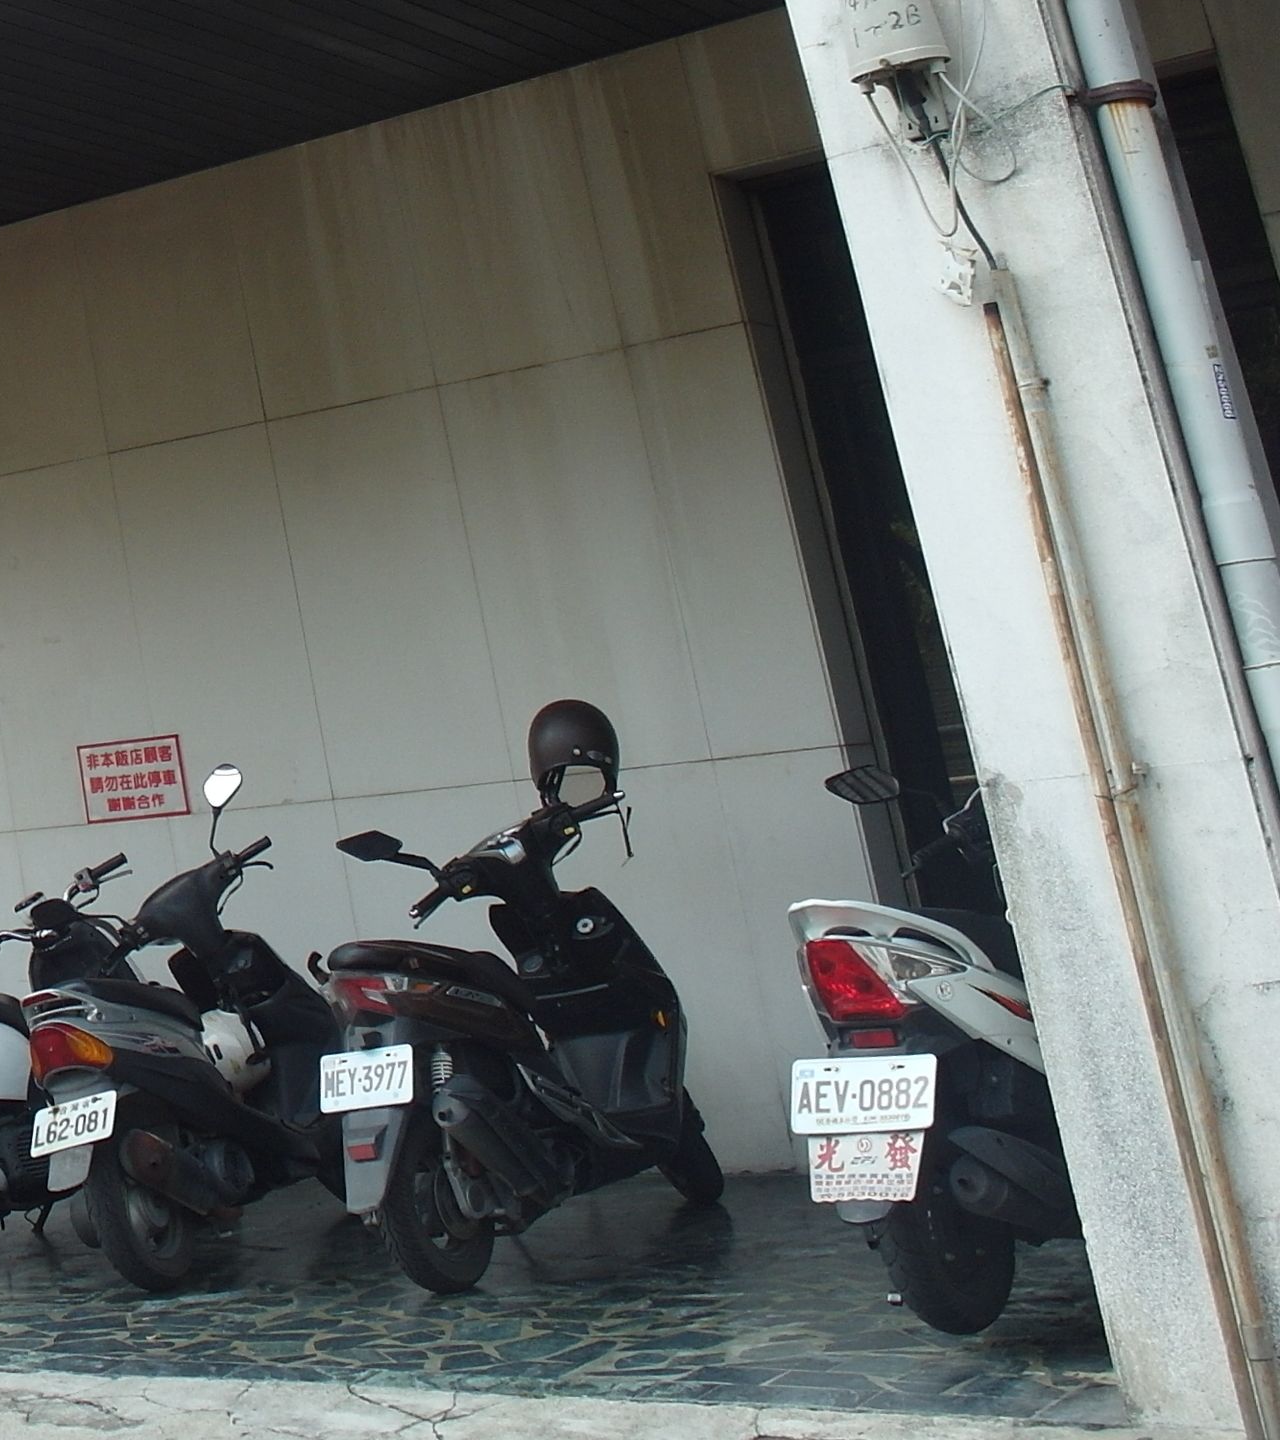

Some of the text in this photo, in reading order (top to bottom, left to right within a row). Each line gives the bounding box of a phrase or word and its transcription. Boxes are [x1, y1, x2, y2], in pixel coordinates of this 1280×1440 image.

[86, 745, 173, 770] 非本飯店顧客
[89, 769, 178, 794] 請勿在此停車
[107, 793, 166, 812] 謝謝合作
